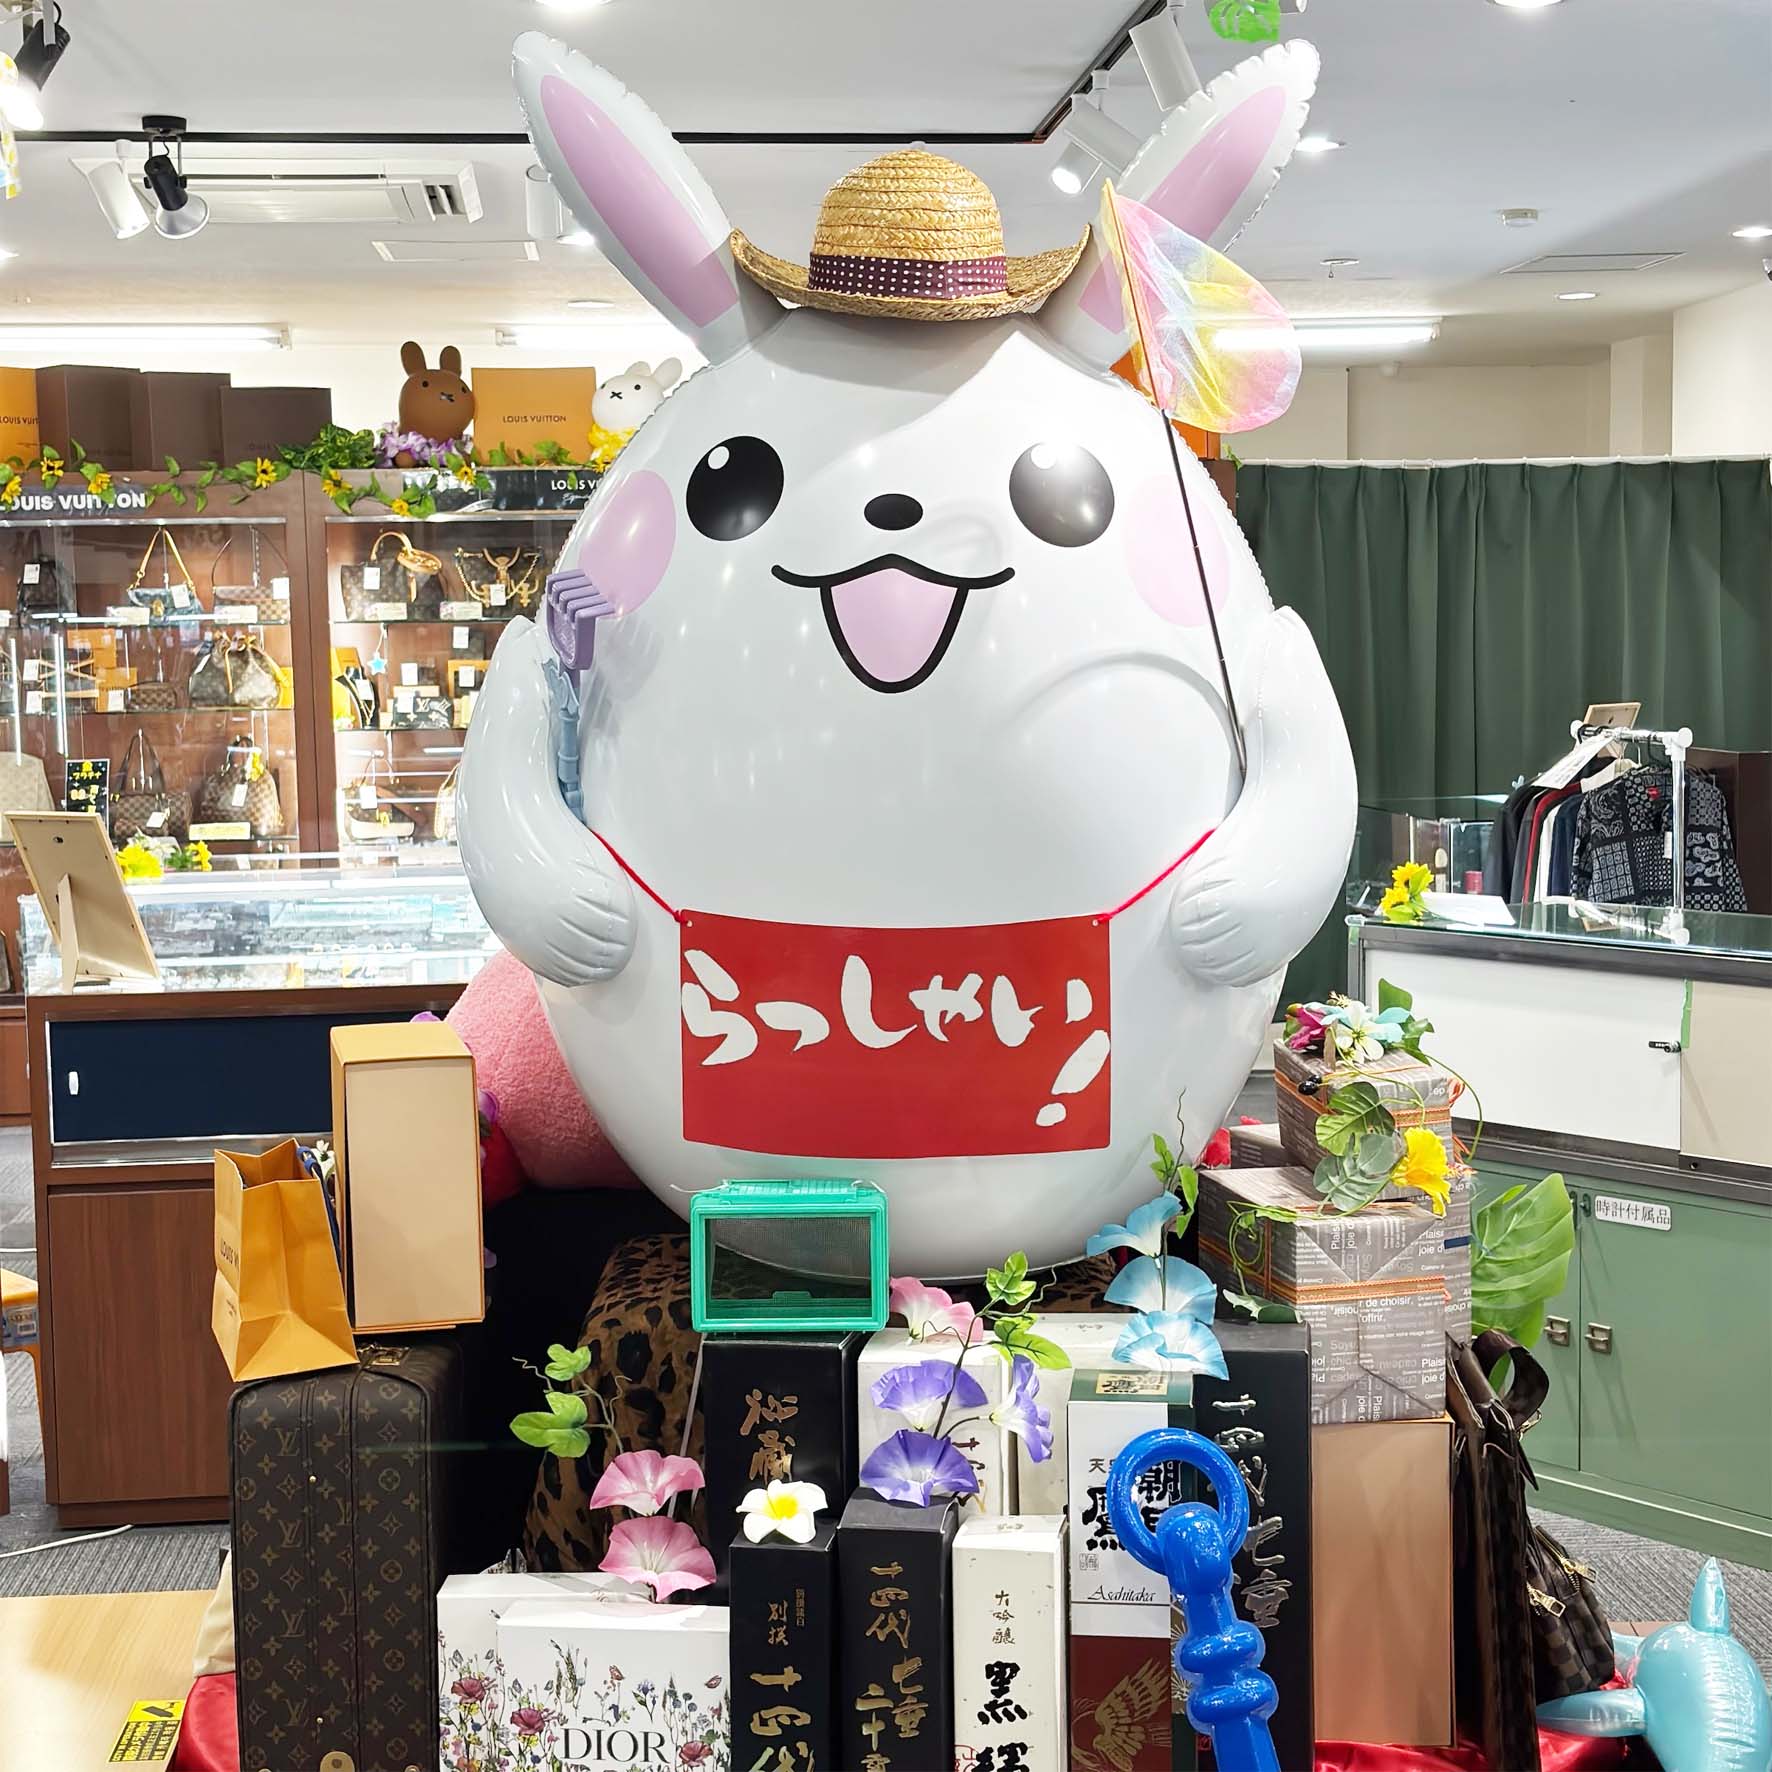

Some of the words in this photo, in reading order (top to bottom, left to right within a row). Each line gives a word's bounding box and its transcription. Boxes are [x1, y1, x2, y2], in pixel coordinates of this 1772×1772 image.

[502, 415, 528, 424] LOUIS
[530, 415, 567, 423] VUITTON
[551, 480, 586, 490] LOIS
[1596, 1199, 1670, 1225] 時計付属品
[1418, 1244, 1434, 1257] joie
[1366, 1299, 1378, 1308] de
[1380, 1296, 1414, 1308] choisir.
[1421, 1374, 1438, 1385] joie
[1356, 1395, 1368, 1413] joie
[1087, 1585, 1156, 1602] Asahitaka
[864, 1561, 909, 1649] 十四代
[560, 1727, 670, 1764] DIOR
